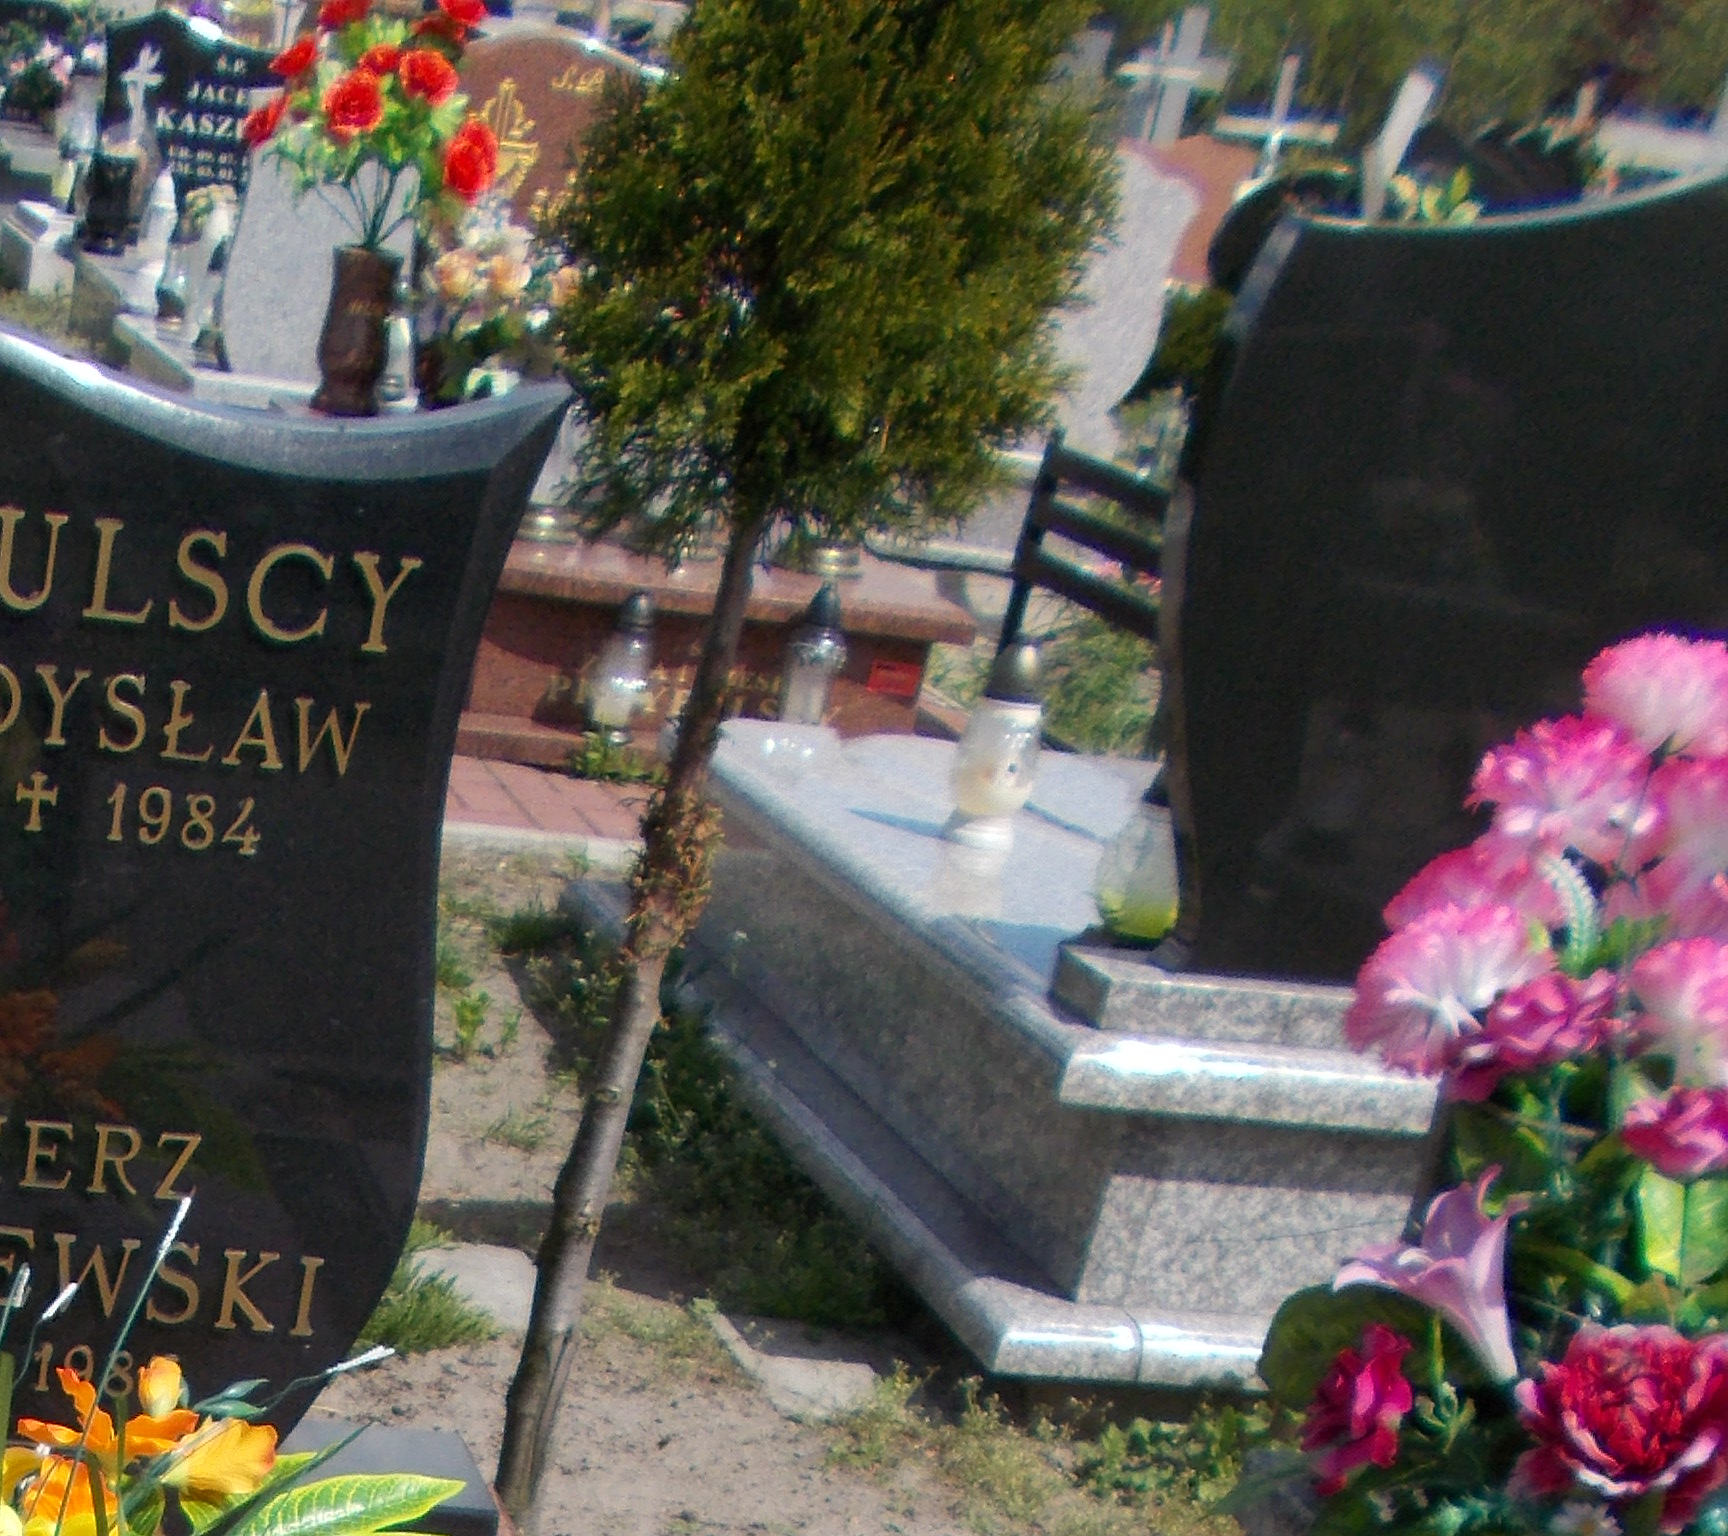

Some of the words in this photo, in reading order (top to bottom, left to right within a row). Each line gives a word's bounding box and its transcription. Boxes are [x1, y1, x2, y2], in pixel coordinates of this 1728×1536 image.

[187, 80, 249, 107] JACE
[106, 781, 260, 855] 1984
[33, 1340, 179, 1397] 198
